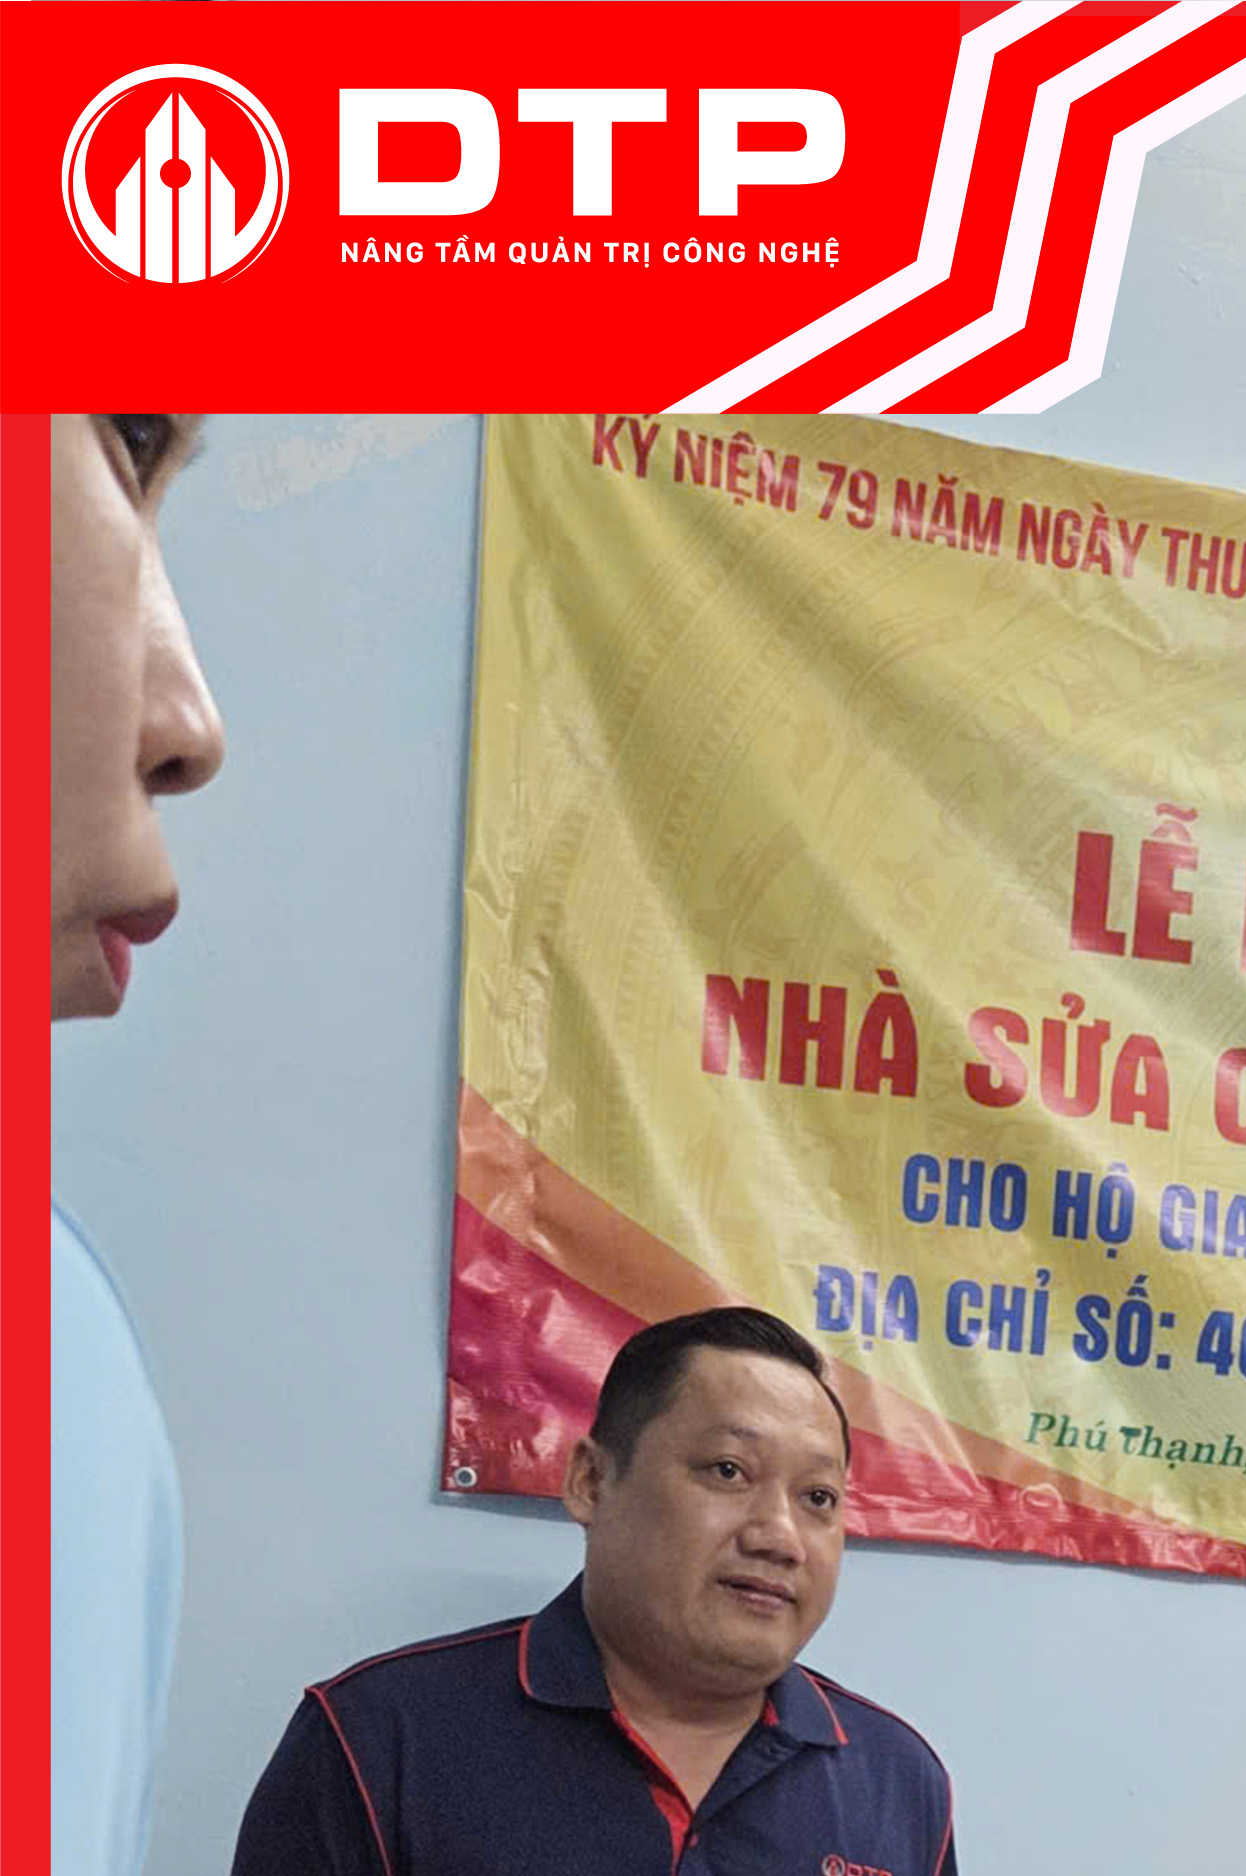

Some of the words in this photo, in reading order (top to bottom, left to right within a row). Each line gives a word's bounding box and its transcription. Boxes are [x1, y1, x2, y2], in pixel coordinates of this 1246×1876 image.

[674, 431, 800, 512] NIỆM
[818, 461, 877, 530] 79
[891, 474, 1004, 557] NĂM
[1017, 502, 1149, 579] NGÀY
[1070, 802, 1198, 965] LỄ
[700, 969, 918, 1098] NHÀ
[964, 992, 1170, 1132] SỬA
[901, 1154, 1027, 1233] CHO
[1052, 1161, 1135, 1258] HỘ
[813, 1264, 920, 1351] ĐỊA
[944, 1268, 1051, 1356] CHỈ
[1071, 1275, 1175, 1369] SỐ:
[1025, 1412, 1108, 1452] Phú
